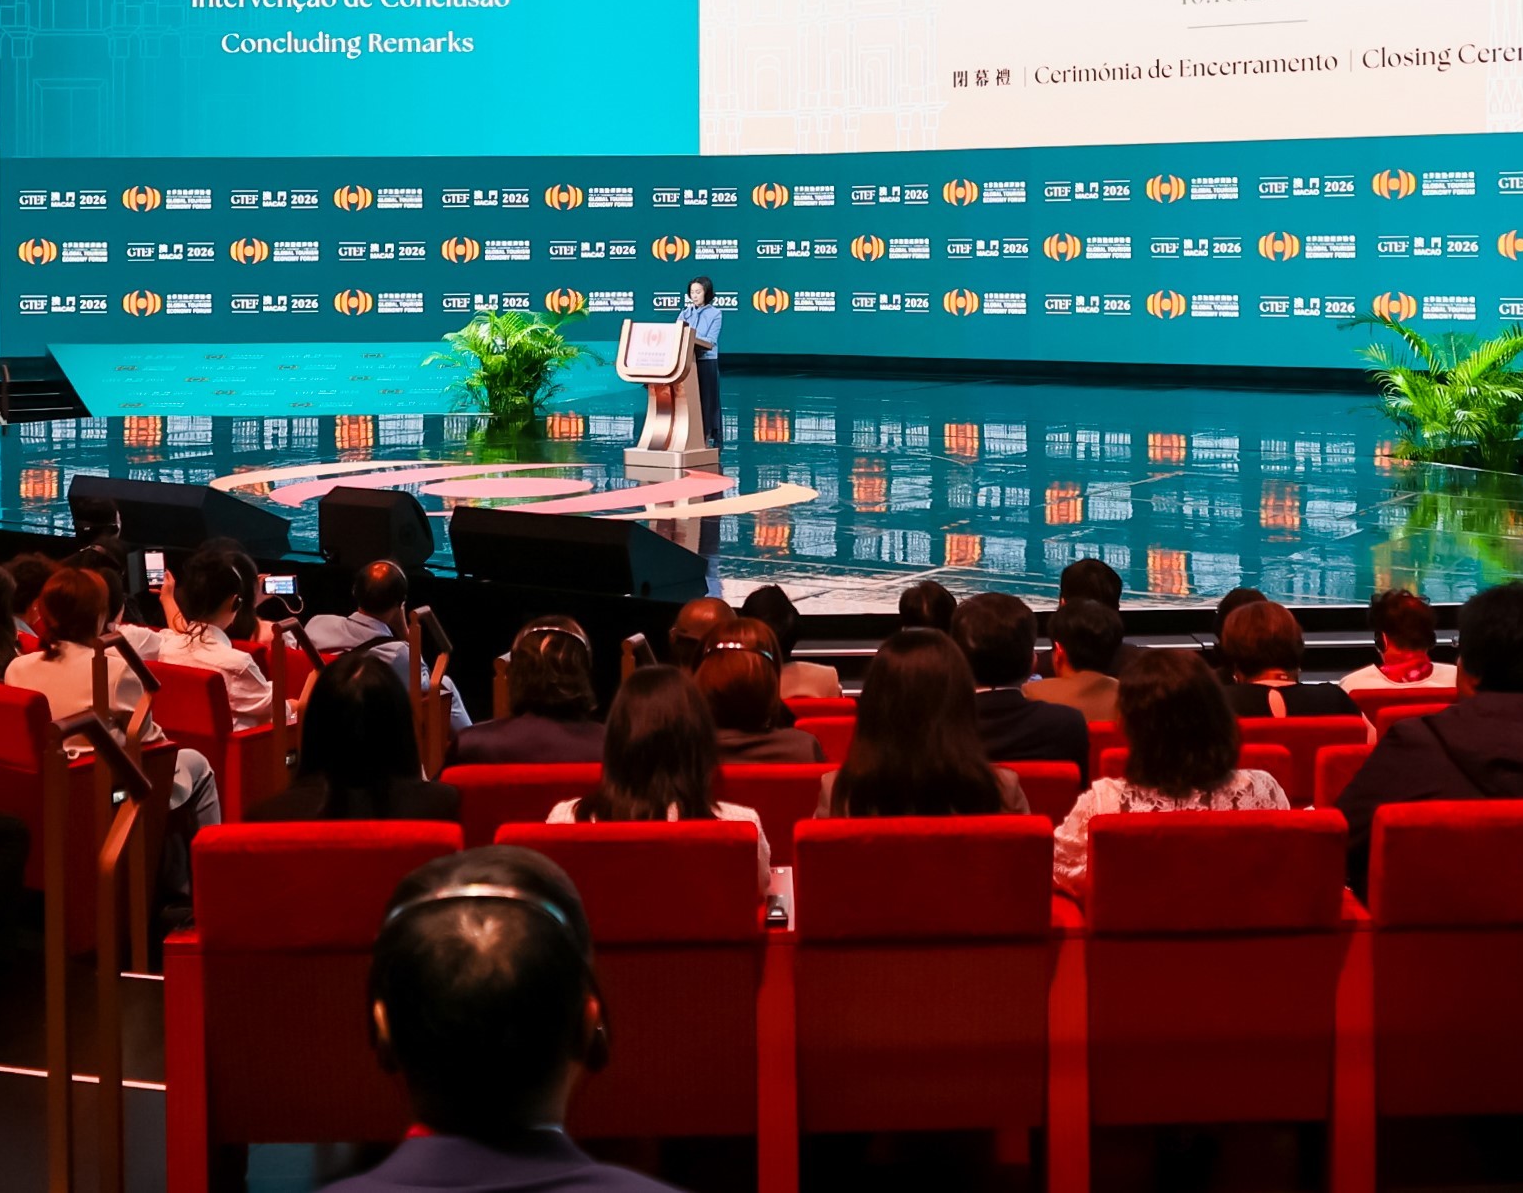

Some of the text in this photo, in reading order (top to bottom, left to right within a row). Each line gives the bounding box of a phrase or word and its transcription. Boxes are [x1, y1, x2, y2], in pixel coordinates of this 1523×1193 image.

[221, 31, 474, 59] Concluding Remarks
[1035, 63, 1141, 84] Cerimónia
[1148, 59, 1172, 78] de
[1180, 55, 1337, 77] Encerramento
[1362, 47, 1451, 72] Closing
